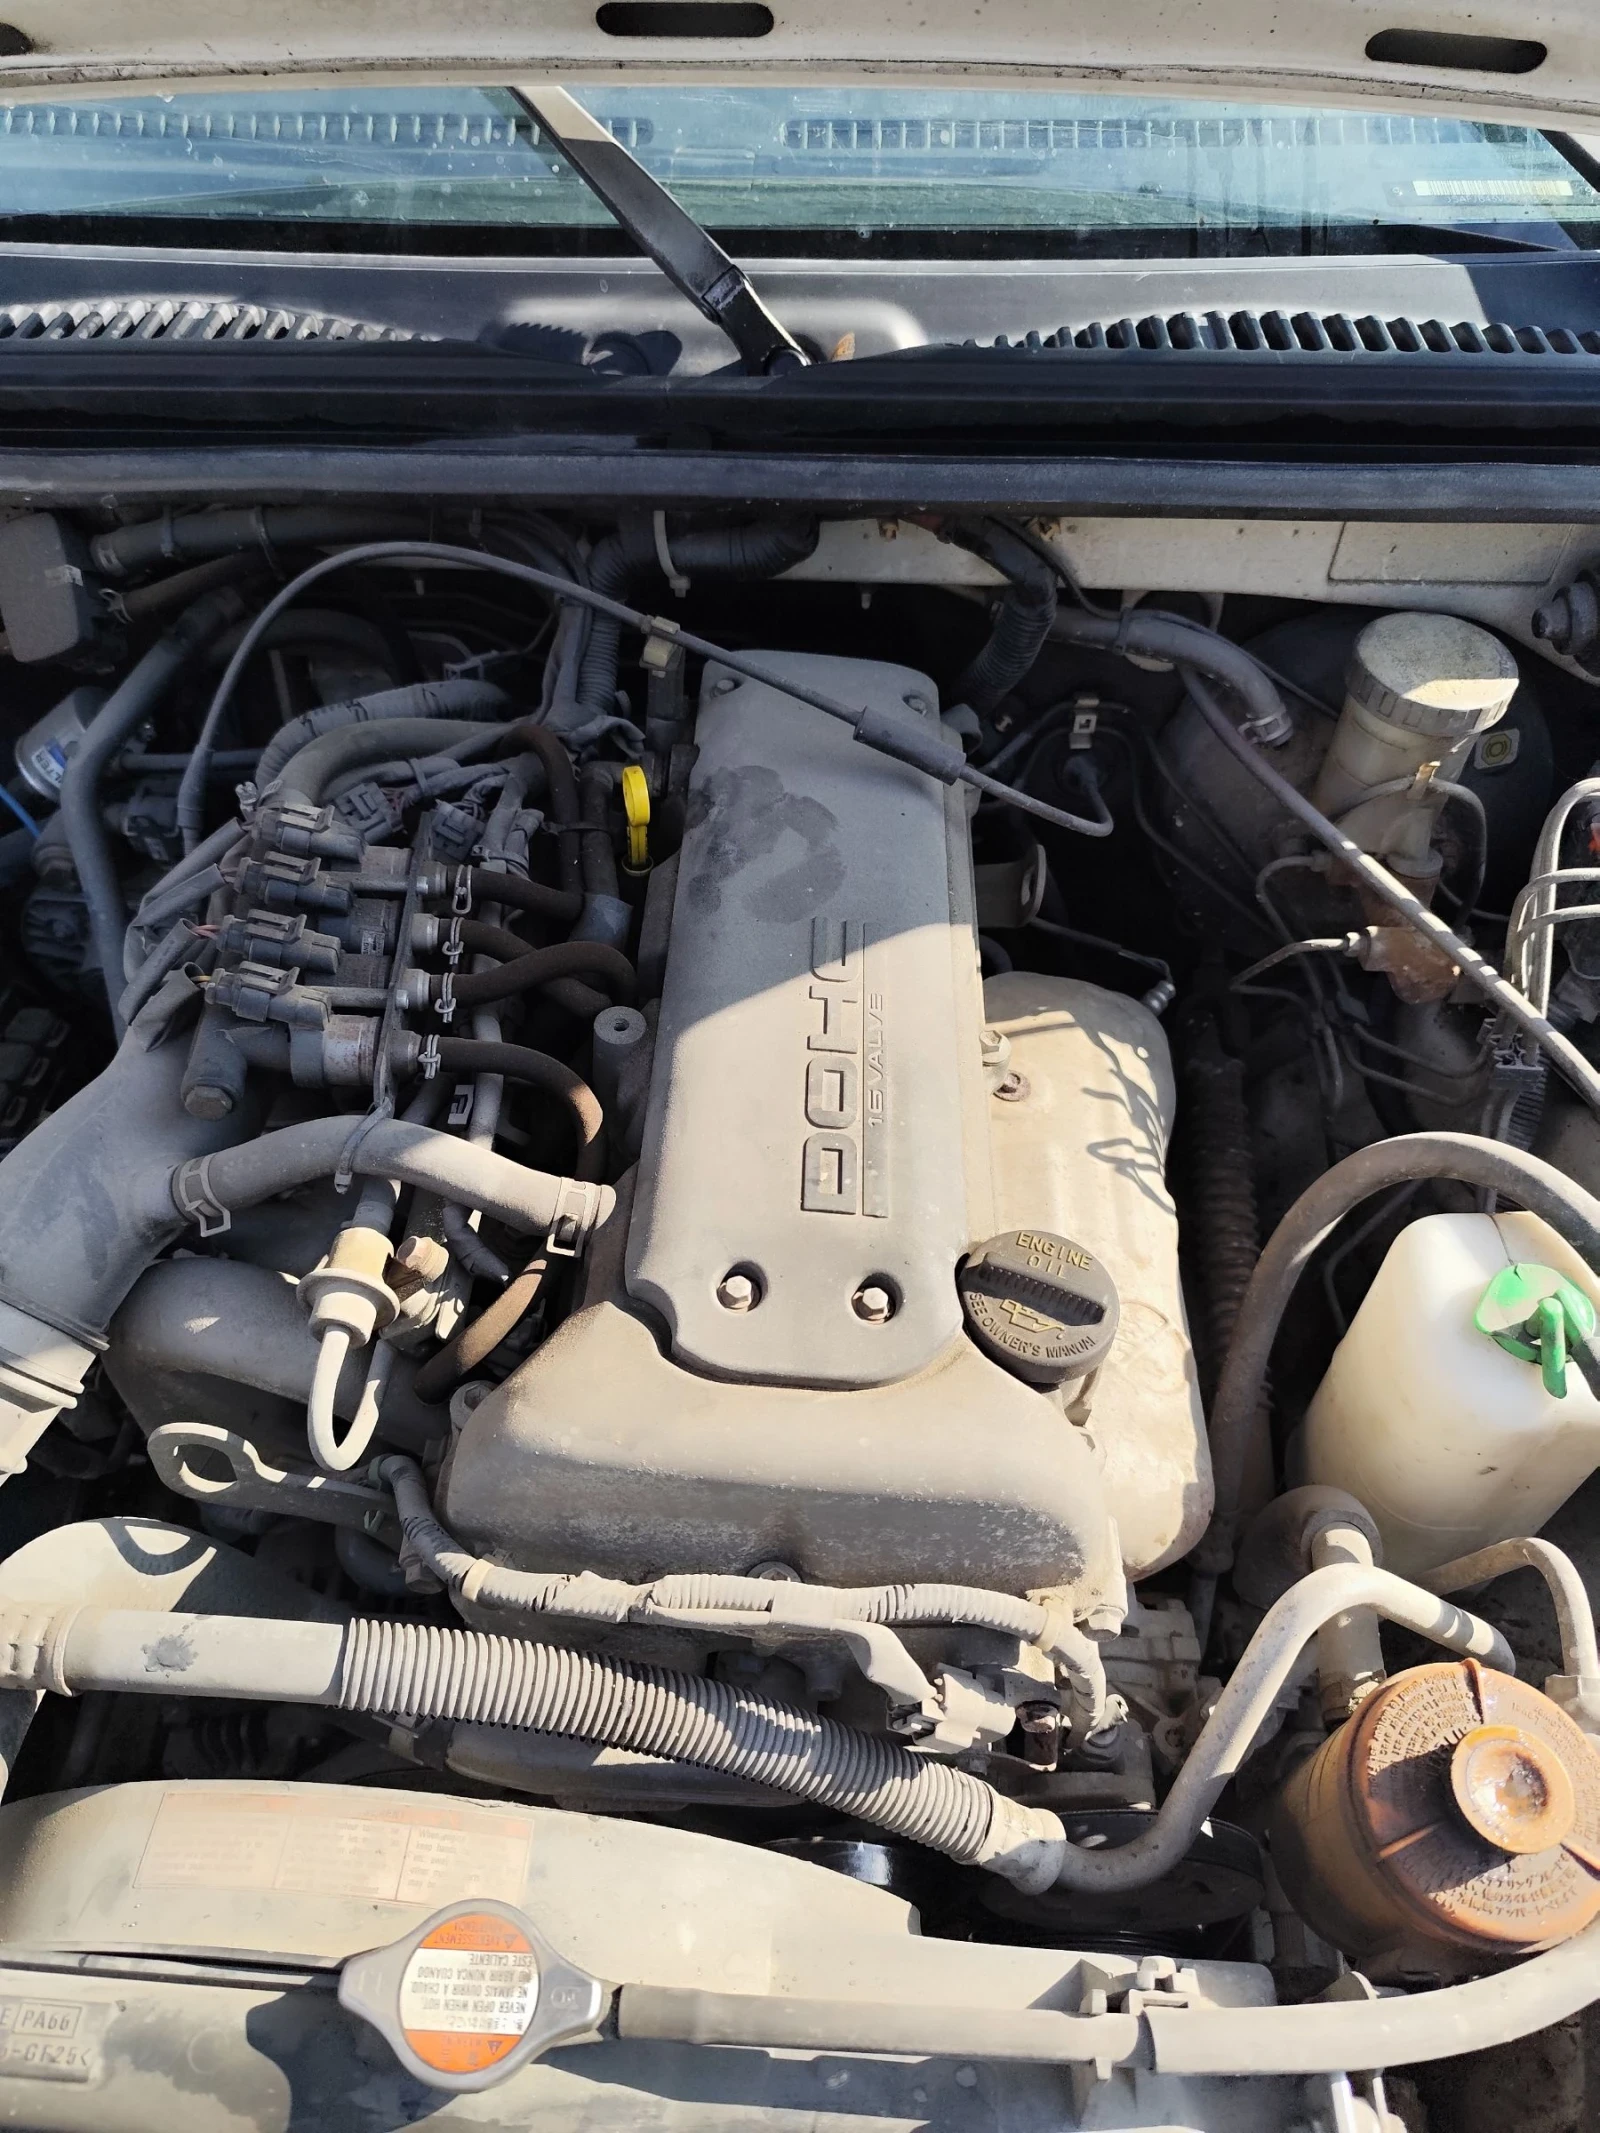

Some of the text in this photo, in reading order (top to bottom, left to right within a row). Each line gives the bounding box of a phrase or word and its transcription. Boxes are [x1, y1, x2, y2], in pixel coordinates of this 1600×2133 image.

[800, 917, 858, 1215] DOHC
[868, 993, 885, 1128] 16 VALVE
[1016, 1232, 1094, 1271] ENGINE
[1027, 1255, 1066, 1279] OIL
[969, 1292, 988, 1316] SEE
[982, 1317, 1041, 1357] OWNER'S
[511, 1954, 534, 1967] ESTE
[417, 1966, 453, 1979] CUANDO
[457, 1968, 486, 1980] NUNCA
[488, 1969, 515, 1981] ABRIR
[452, 1983, 482, 1996] OUVRIR
[485, 1984, 515, 1997] JAMAIS
[444, 1999, 469, 2011] WHEN
[473, 2000, 496, 2012] OPEN
[498, 2000, 526, 2013] NEVER
[22, 2009, 71, 2031] PA66
